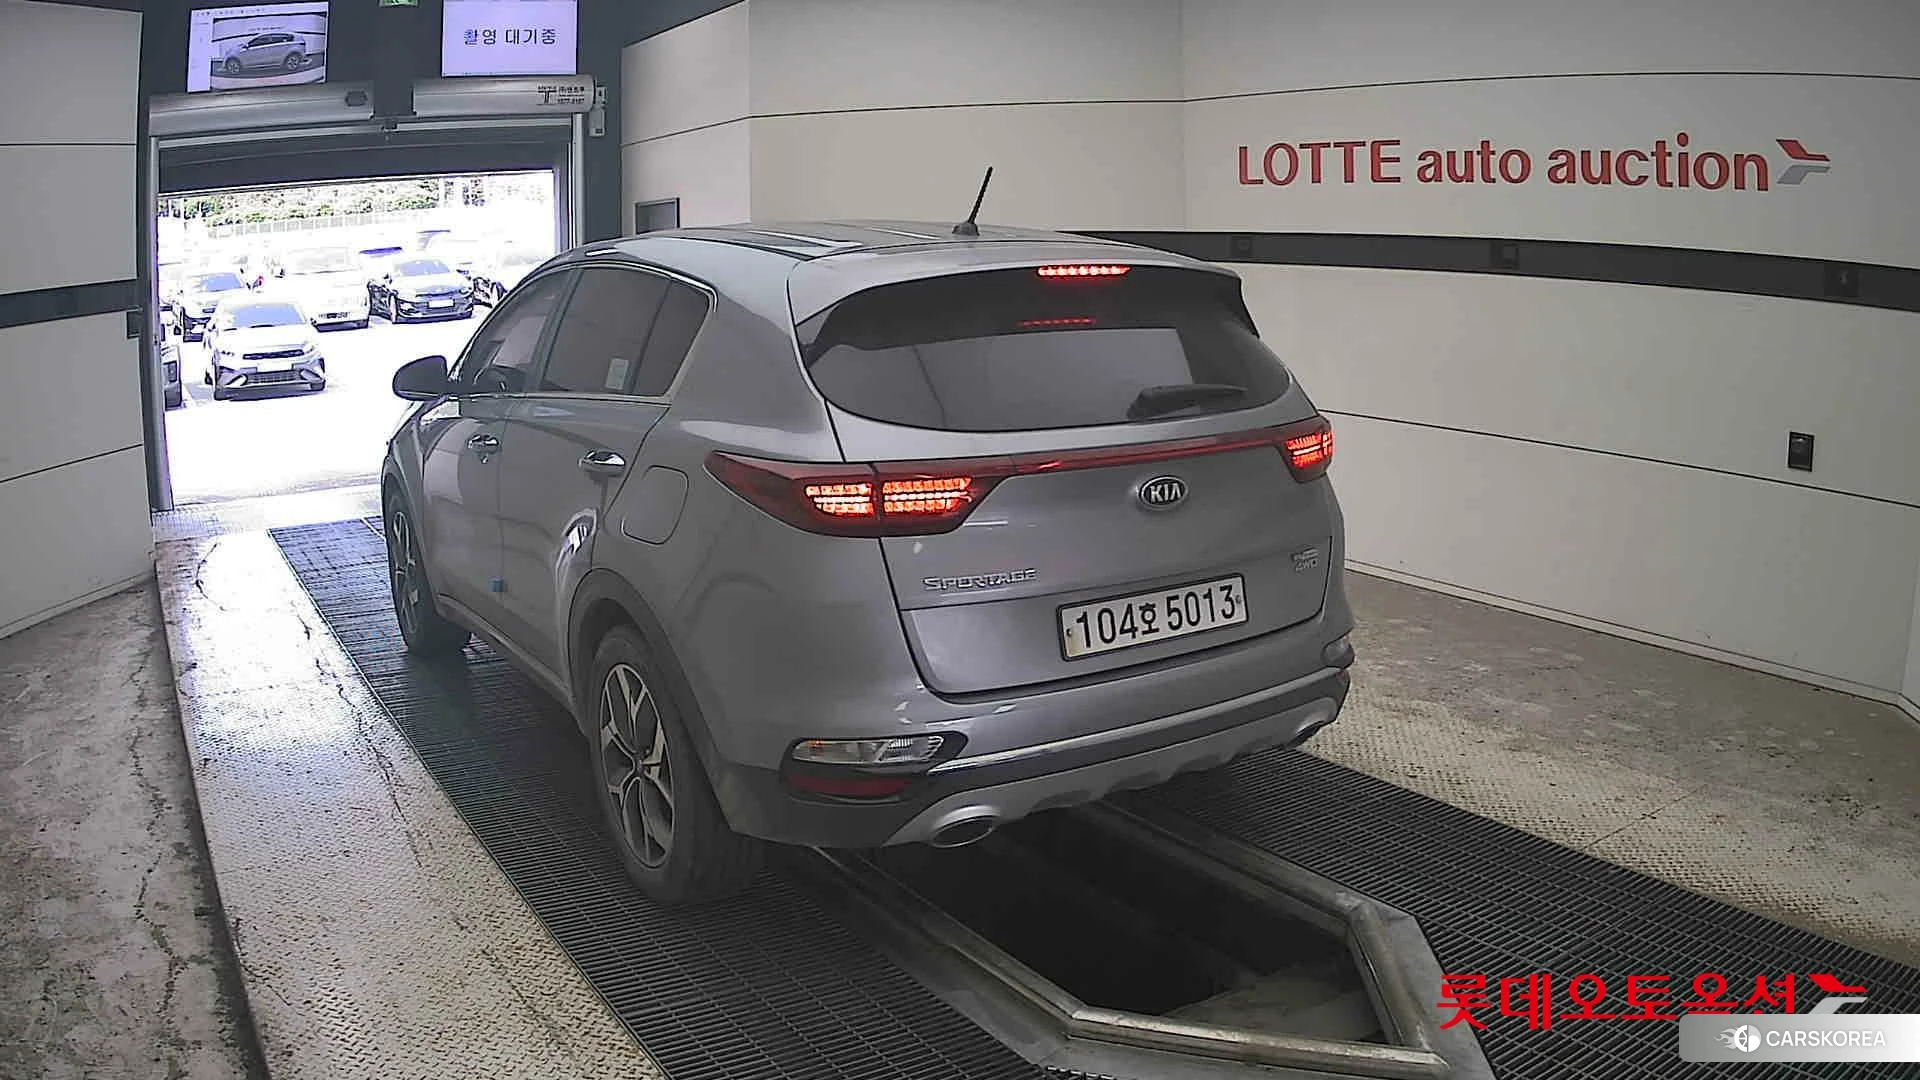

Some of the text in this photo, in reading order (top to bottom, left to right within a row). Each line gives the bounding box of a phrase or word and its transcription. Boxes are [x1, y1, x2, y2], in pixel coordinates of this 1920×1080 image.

[464, 28, 557, 46] 촬영 대기중
[1238, 132, 1770, 191] LOTTE auto auction
[1149, 482, 1182, 503] KIA
[922, 567, 1038, 592] SPORTAGE
[1076, 584, 1236, 648] 104호 5013
